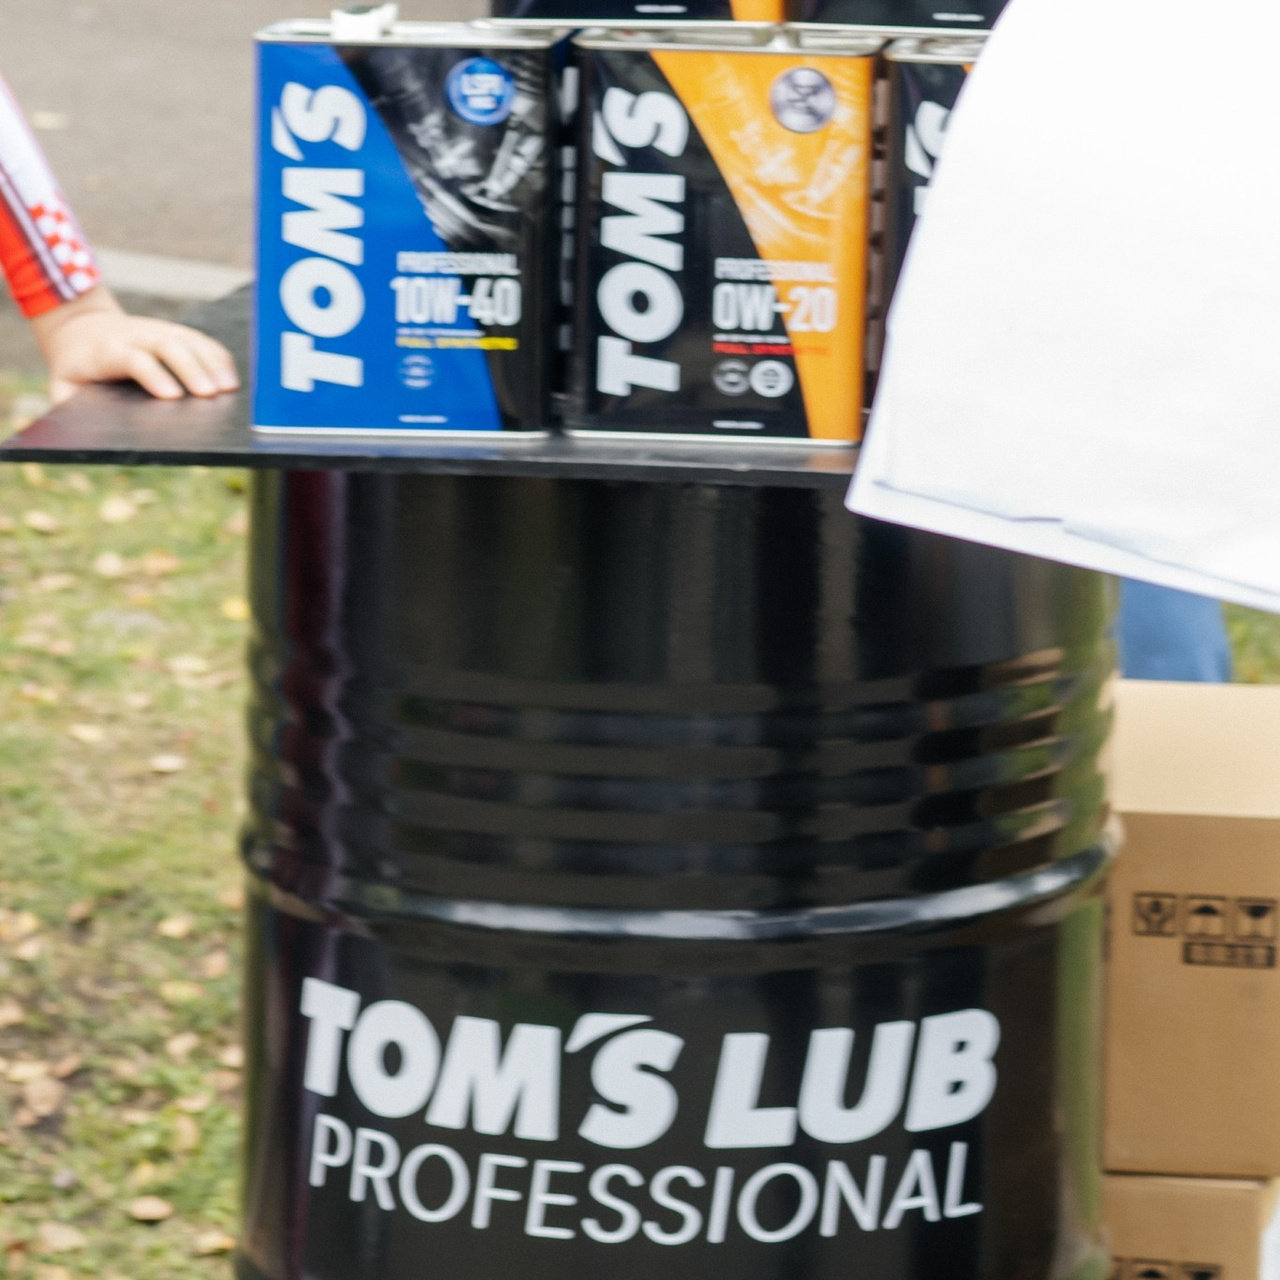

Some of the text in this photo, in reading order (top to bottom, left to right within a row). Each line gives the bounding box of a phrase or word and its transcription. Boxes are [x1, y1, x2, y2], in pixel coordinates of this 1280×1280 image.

[271, 81, 367, 393] TOM'S
[390, 275, 522, 327] 10W-40
[592, 86, 690, 397] TOM'S
[712, 283, 838, 334] 0W-20
[300, 976, 1001, 1150] TOM'S LUB
[308, 1113, 986, 1246] PROFESSIONAL
